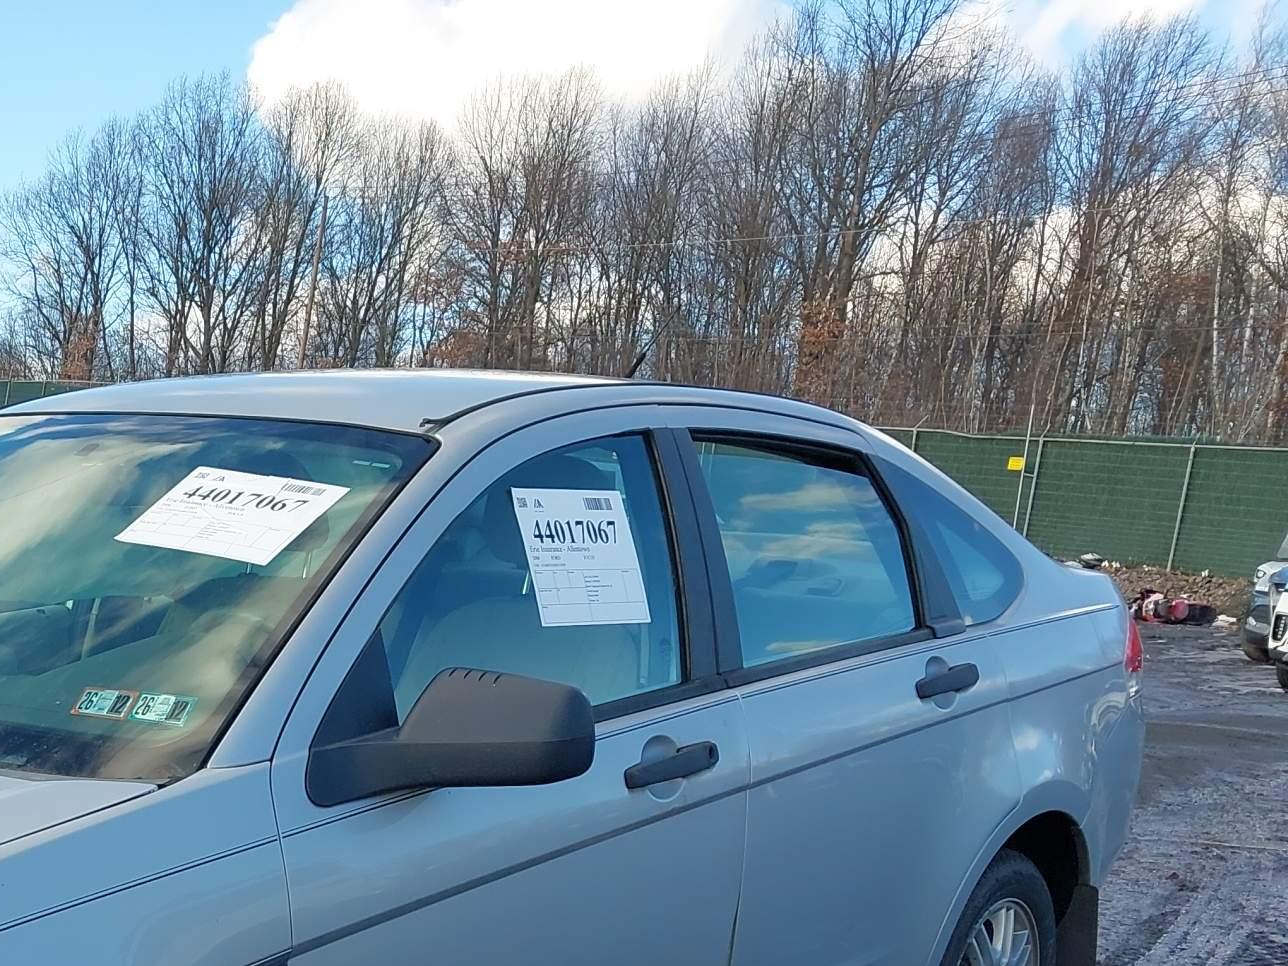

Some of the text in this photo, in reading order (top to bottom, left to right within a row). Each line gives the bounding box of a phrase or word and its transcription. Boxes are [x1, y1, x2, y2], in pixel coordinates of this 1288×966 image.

[183, 485, 311, 513] 44017067
[533, 519, 617, 544] 44017067
[78, 691, 98, 710] 26
[108, 694, 131, 715] 12
[134, 696, 154, 716] 26
[165, 701, 189, 721] 12
